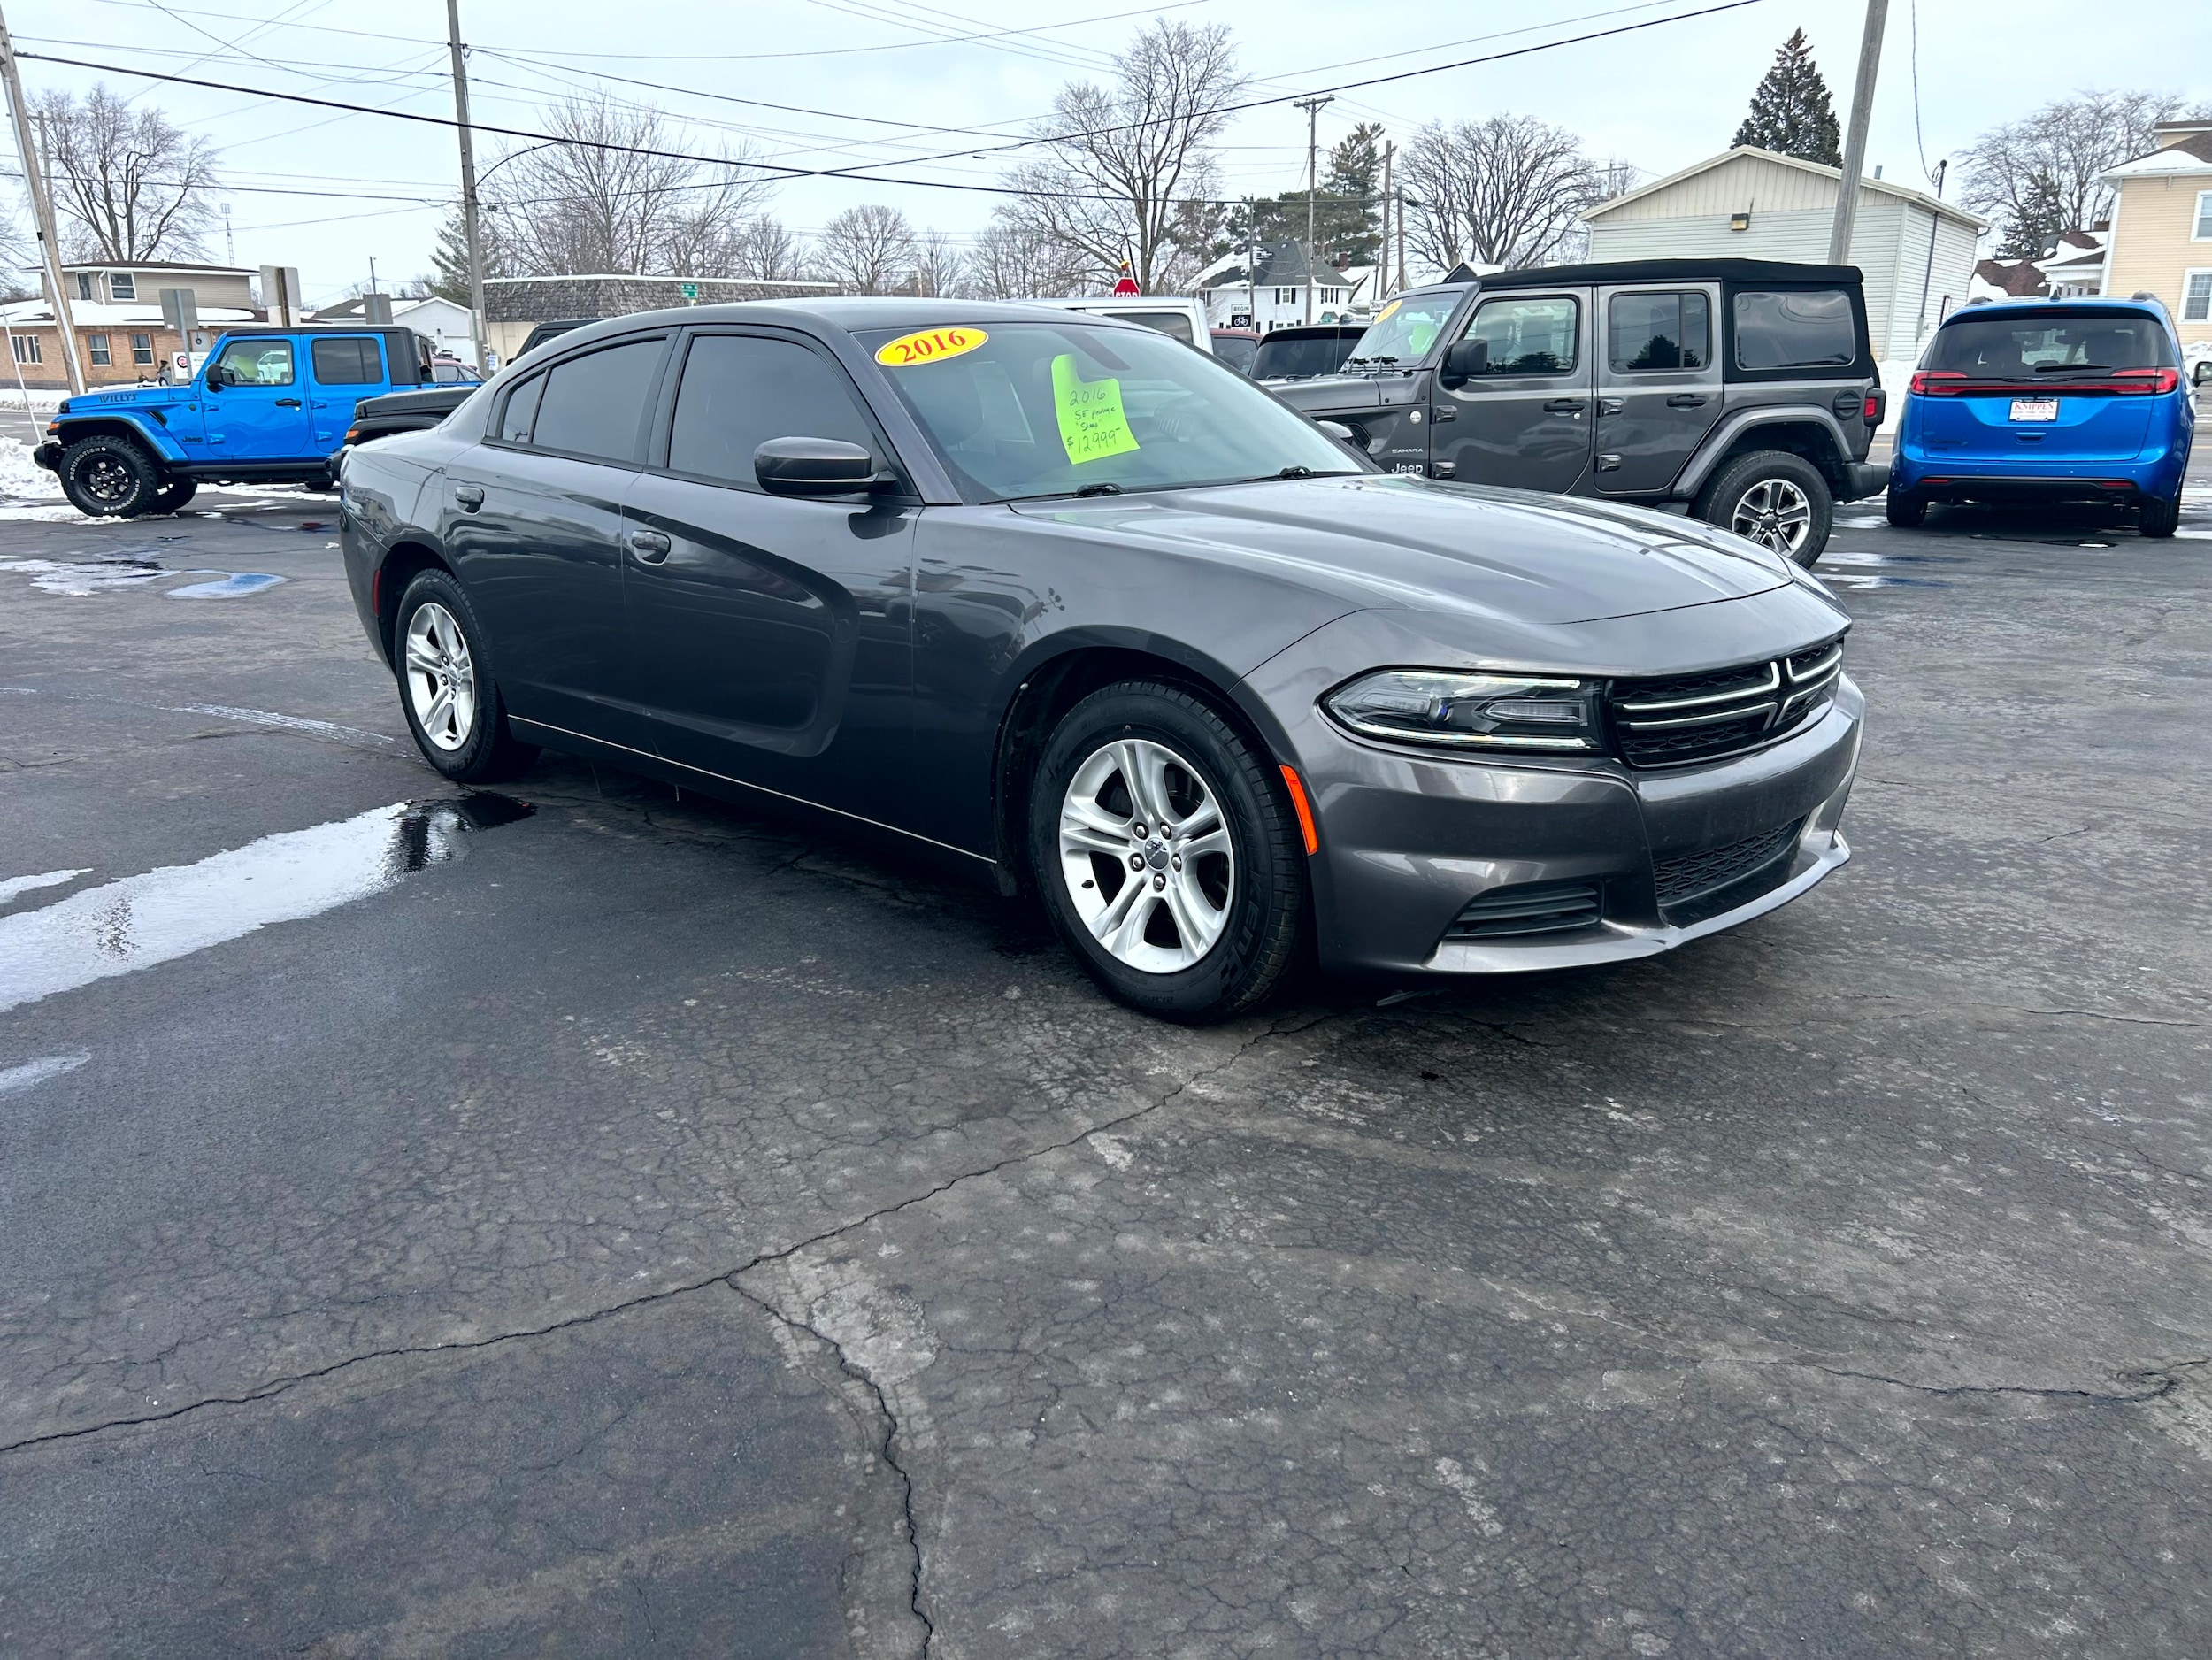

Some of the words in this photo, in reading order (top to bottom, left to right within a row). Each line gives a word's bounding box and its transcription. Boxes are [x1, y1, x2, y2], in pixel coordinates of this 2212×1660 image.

[895, 330, 966, 363] 2016
[99, 393, 138, 403] WILLYS
[1069, 387, 1106, 406] 2016
[1390, 462, 1424, 474] Jeep
